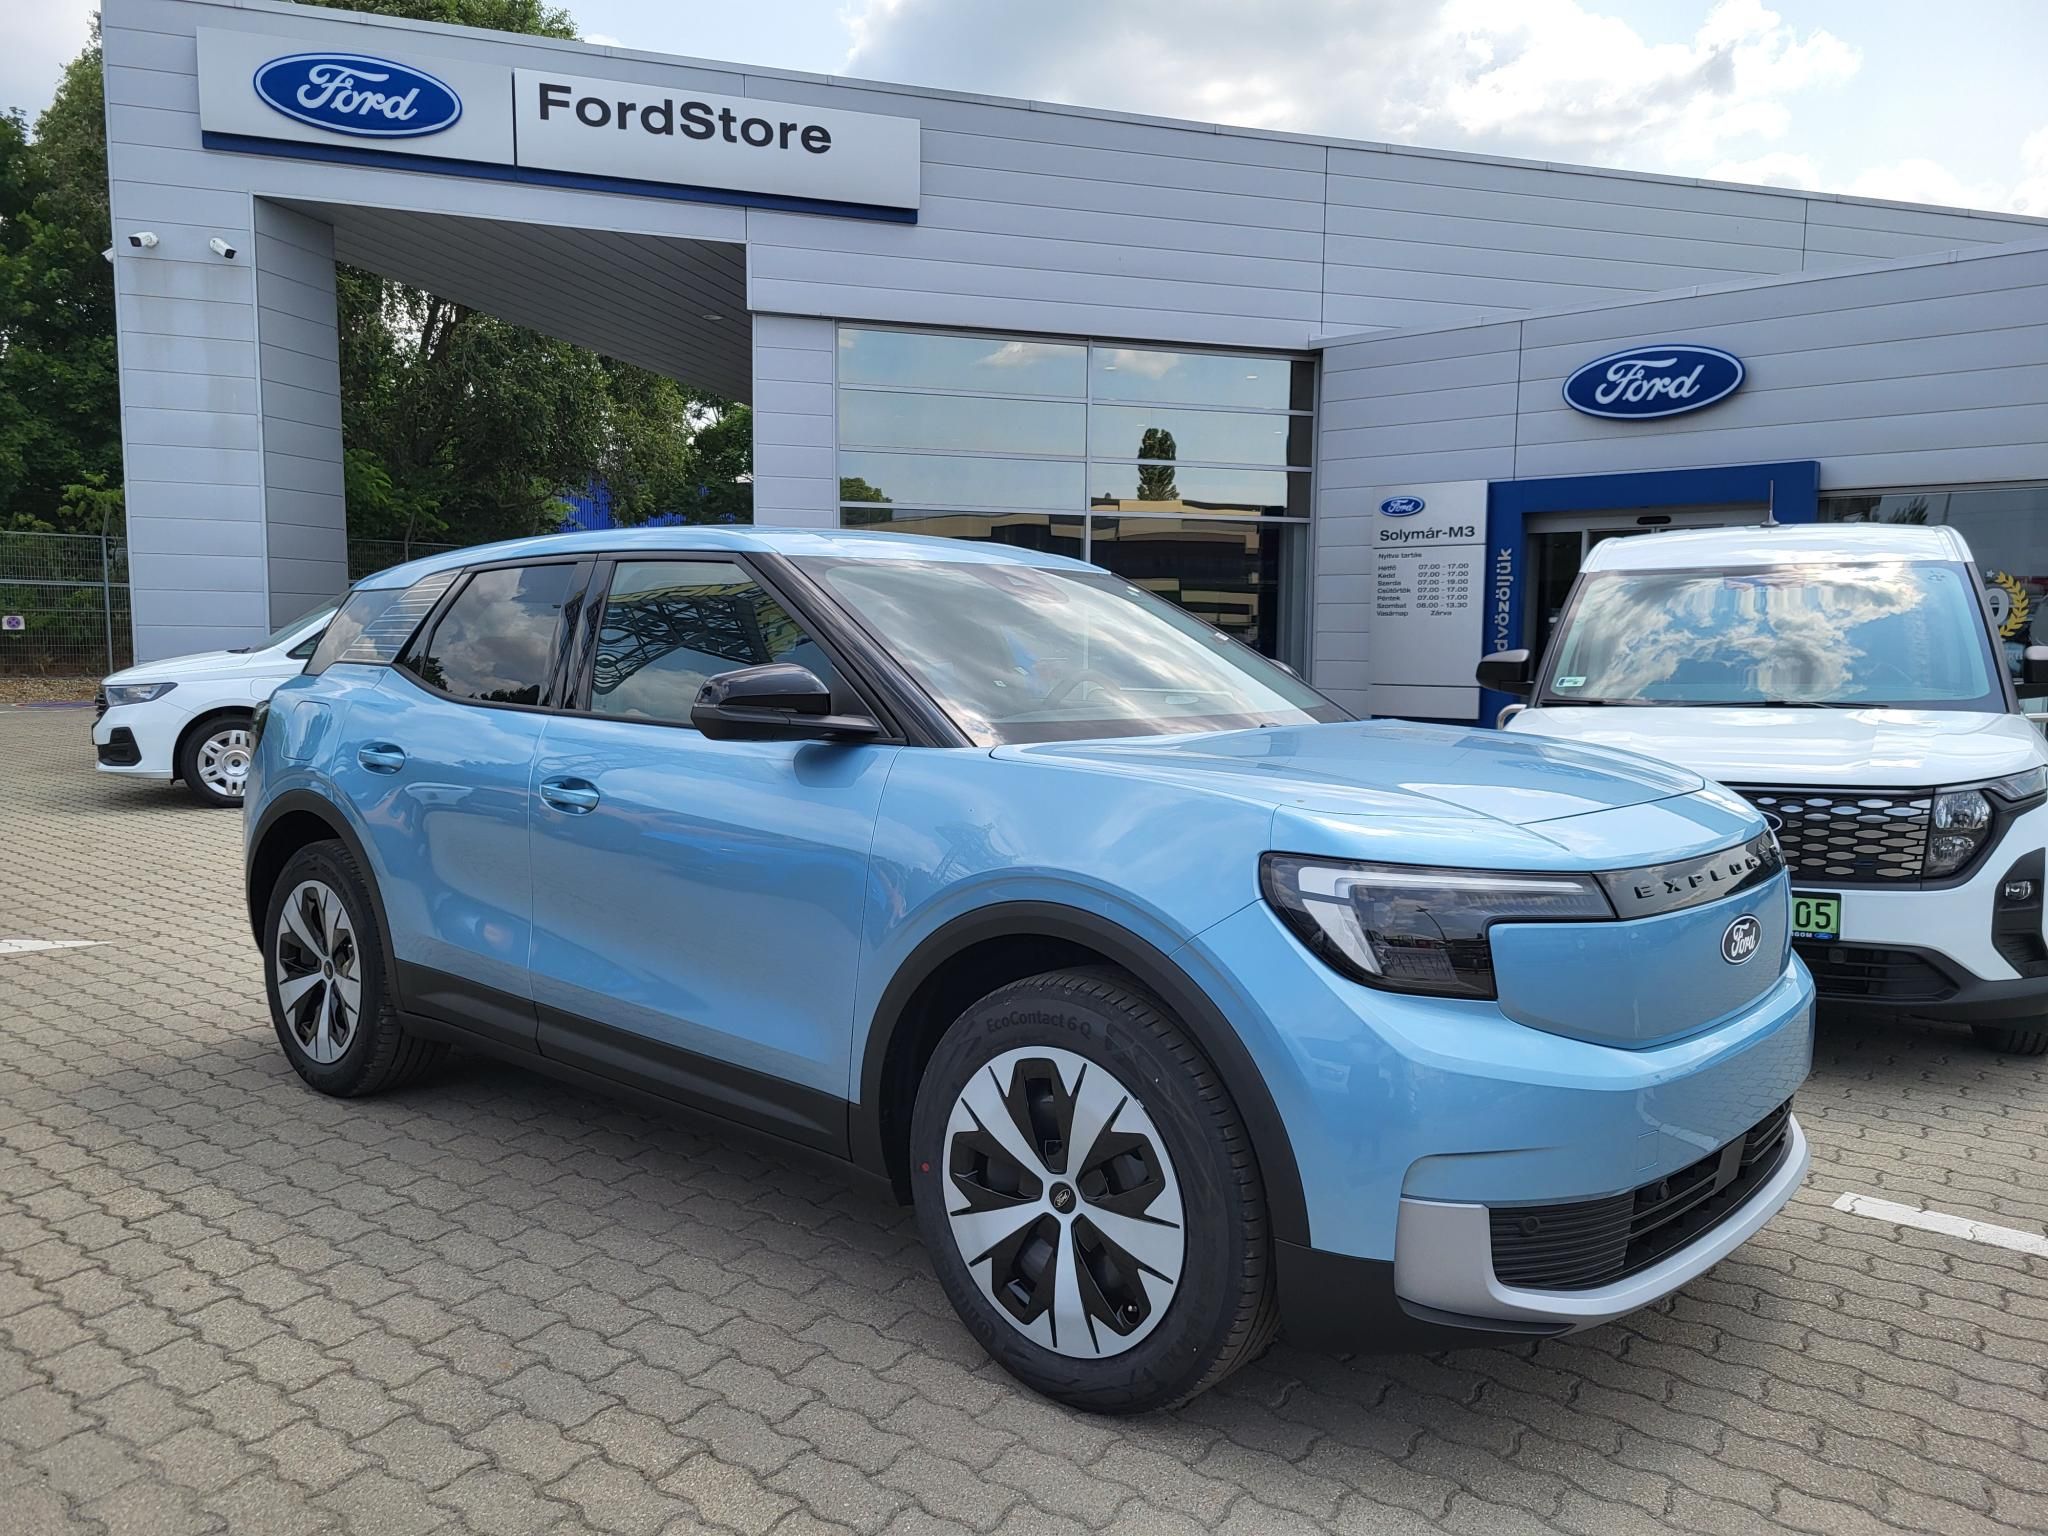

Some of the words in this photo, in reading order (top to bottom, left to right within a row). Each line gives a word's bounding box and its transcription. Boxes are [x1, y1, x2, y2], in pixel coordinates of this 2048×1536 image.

[295, 60, 421, 124] Ford
[538, 82, 832, 155] FordStore
[1595, 357, 1705, 404] Ford
[1379, 525, 1476, 543] Solymár-M3
[1494, 548, 1514, 652] dvözöljük
[1795, 900, 1832, 930] 05
[986, 1010, 1065, 1034] EcoContact
[1067, 1016, 1078, 1032] 6
[1079, 1020, 1092, 1040] Q
